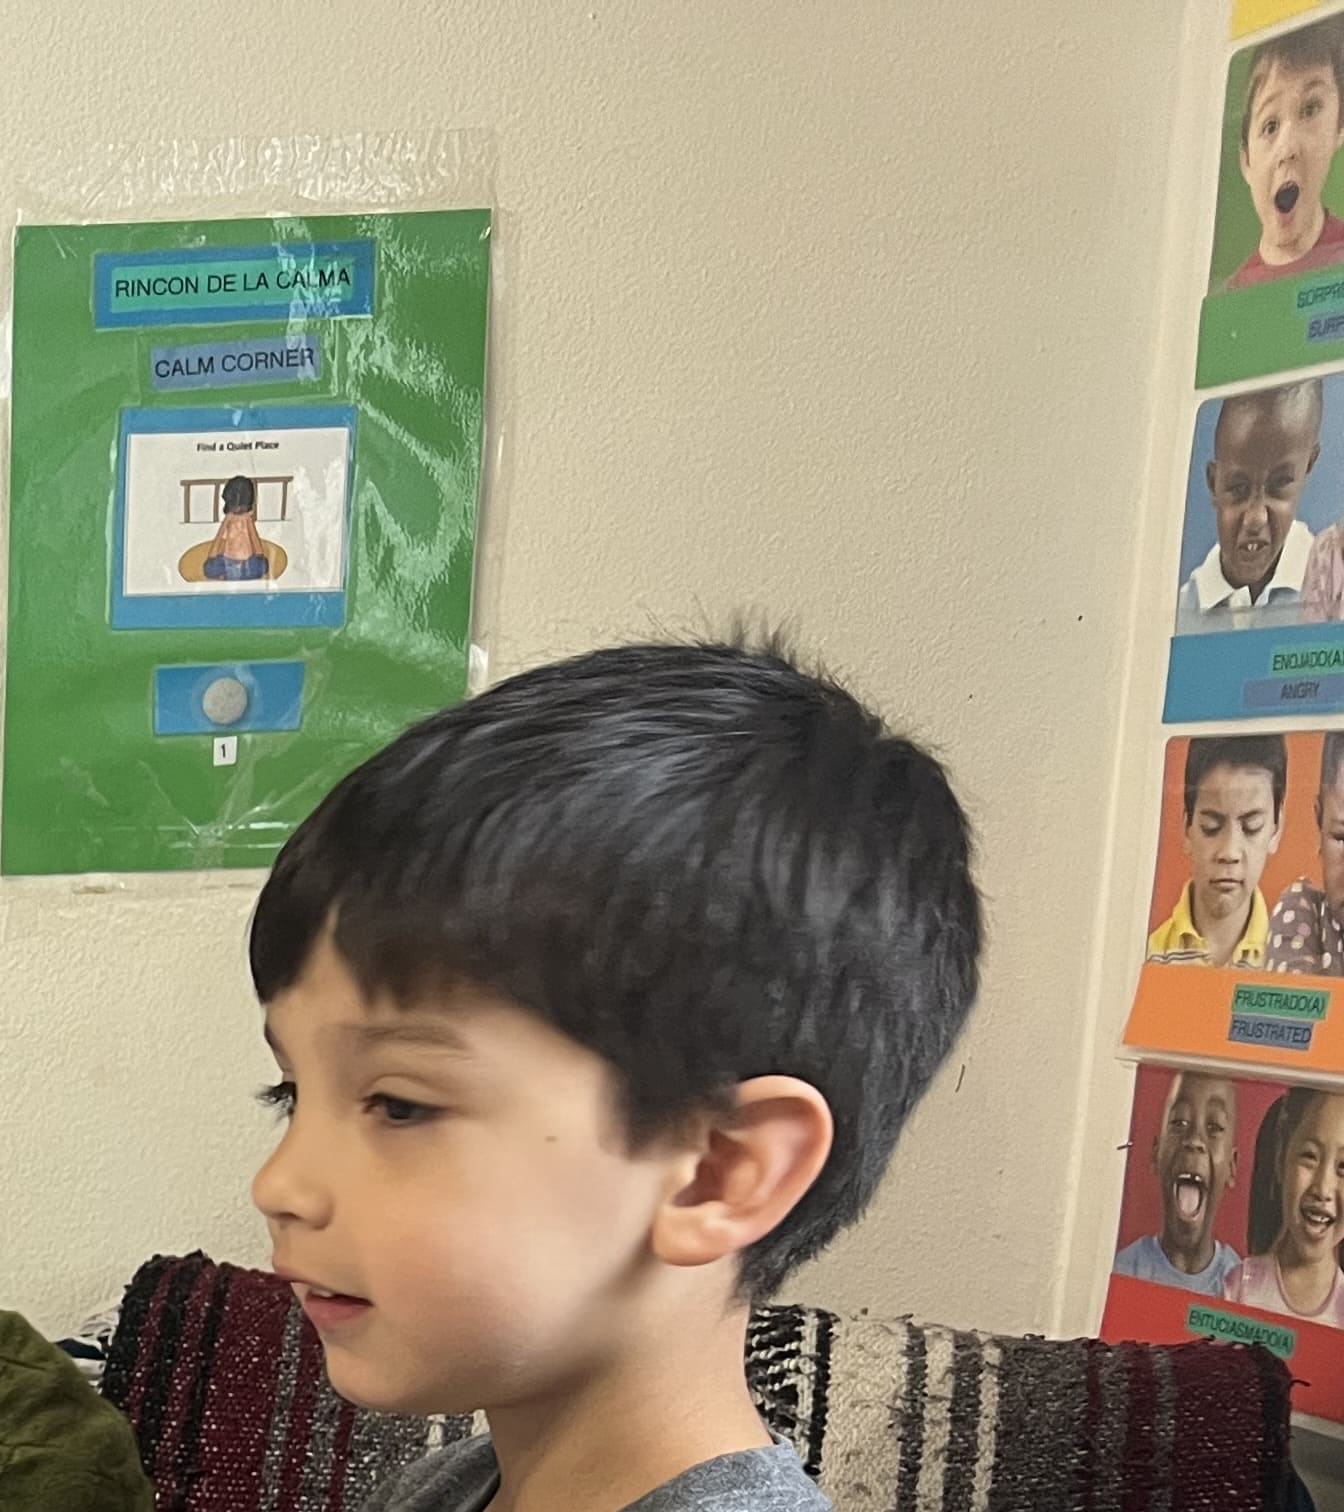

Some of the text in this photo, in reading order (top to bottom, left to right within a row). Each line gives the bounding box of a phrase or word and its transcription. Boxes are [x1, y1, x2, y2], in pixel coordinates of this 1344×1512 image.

[115, 268, 351, 298] RINCON DE LA CALMA
[154, 347, 314, 378] CALM CORNER
[1230, 1019, 1313, 1044] FRUSTRATED
